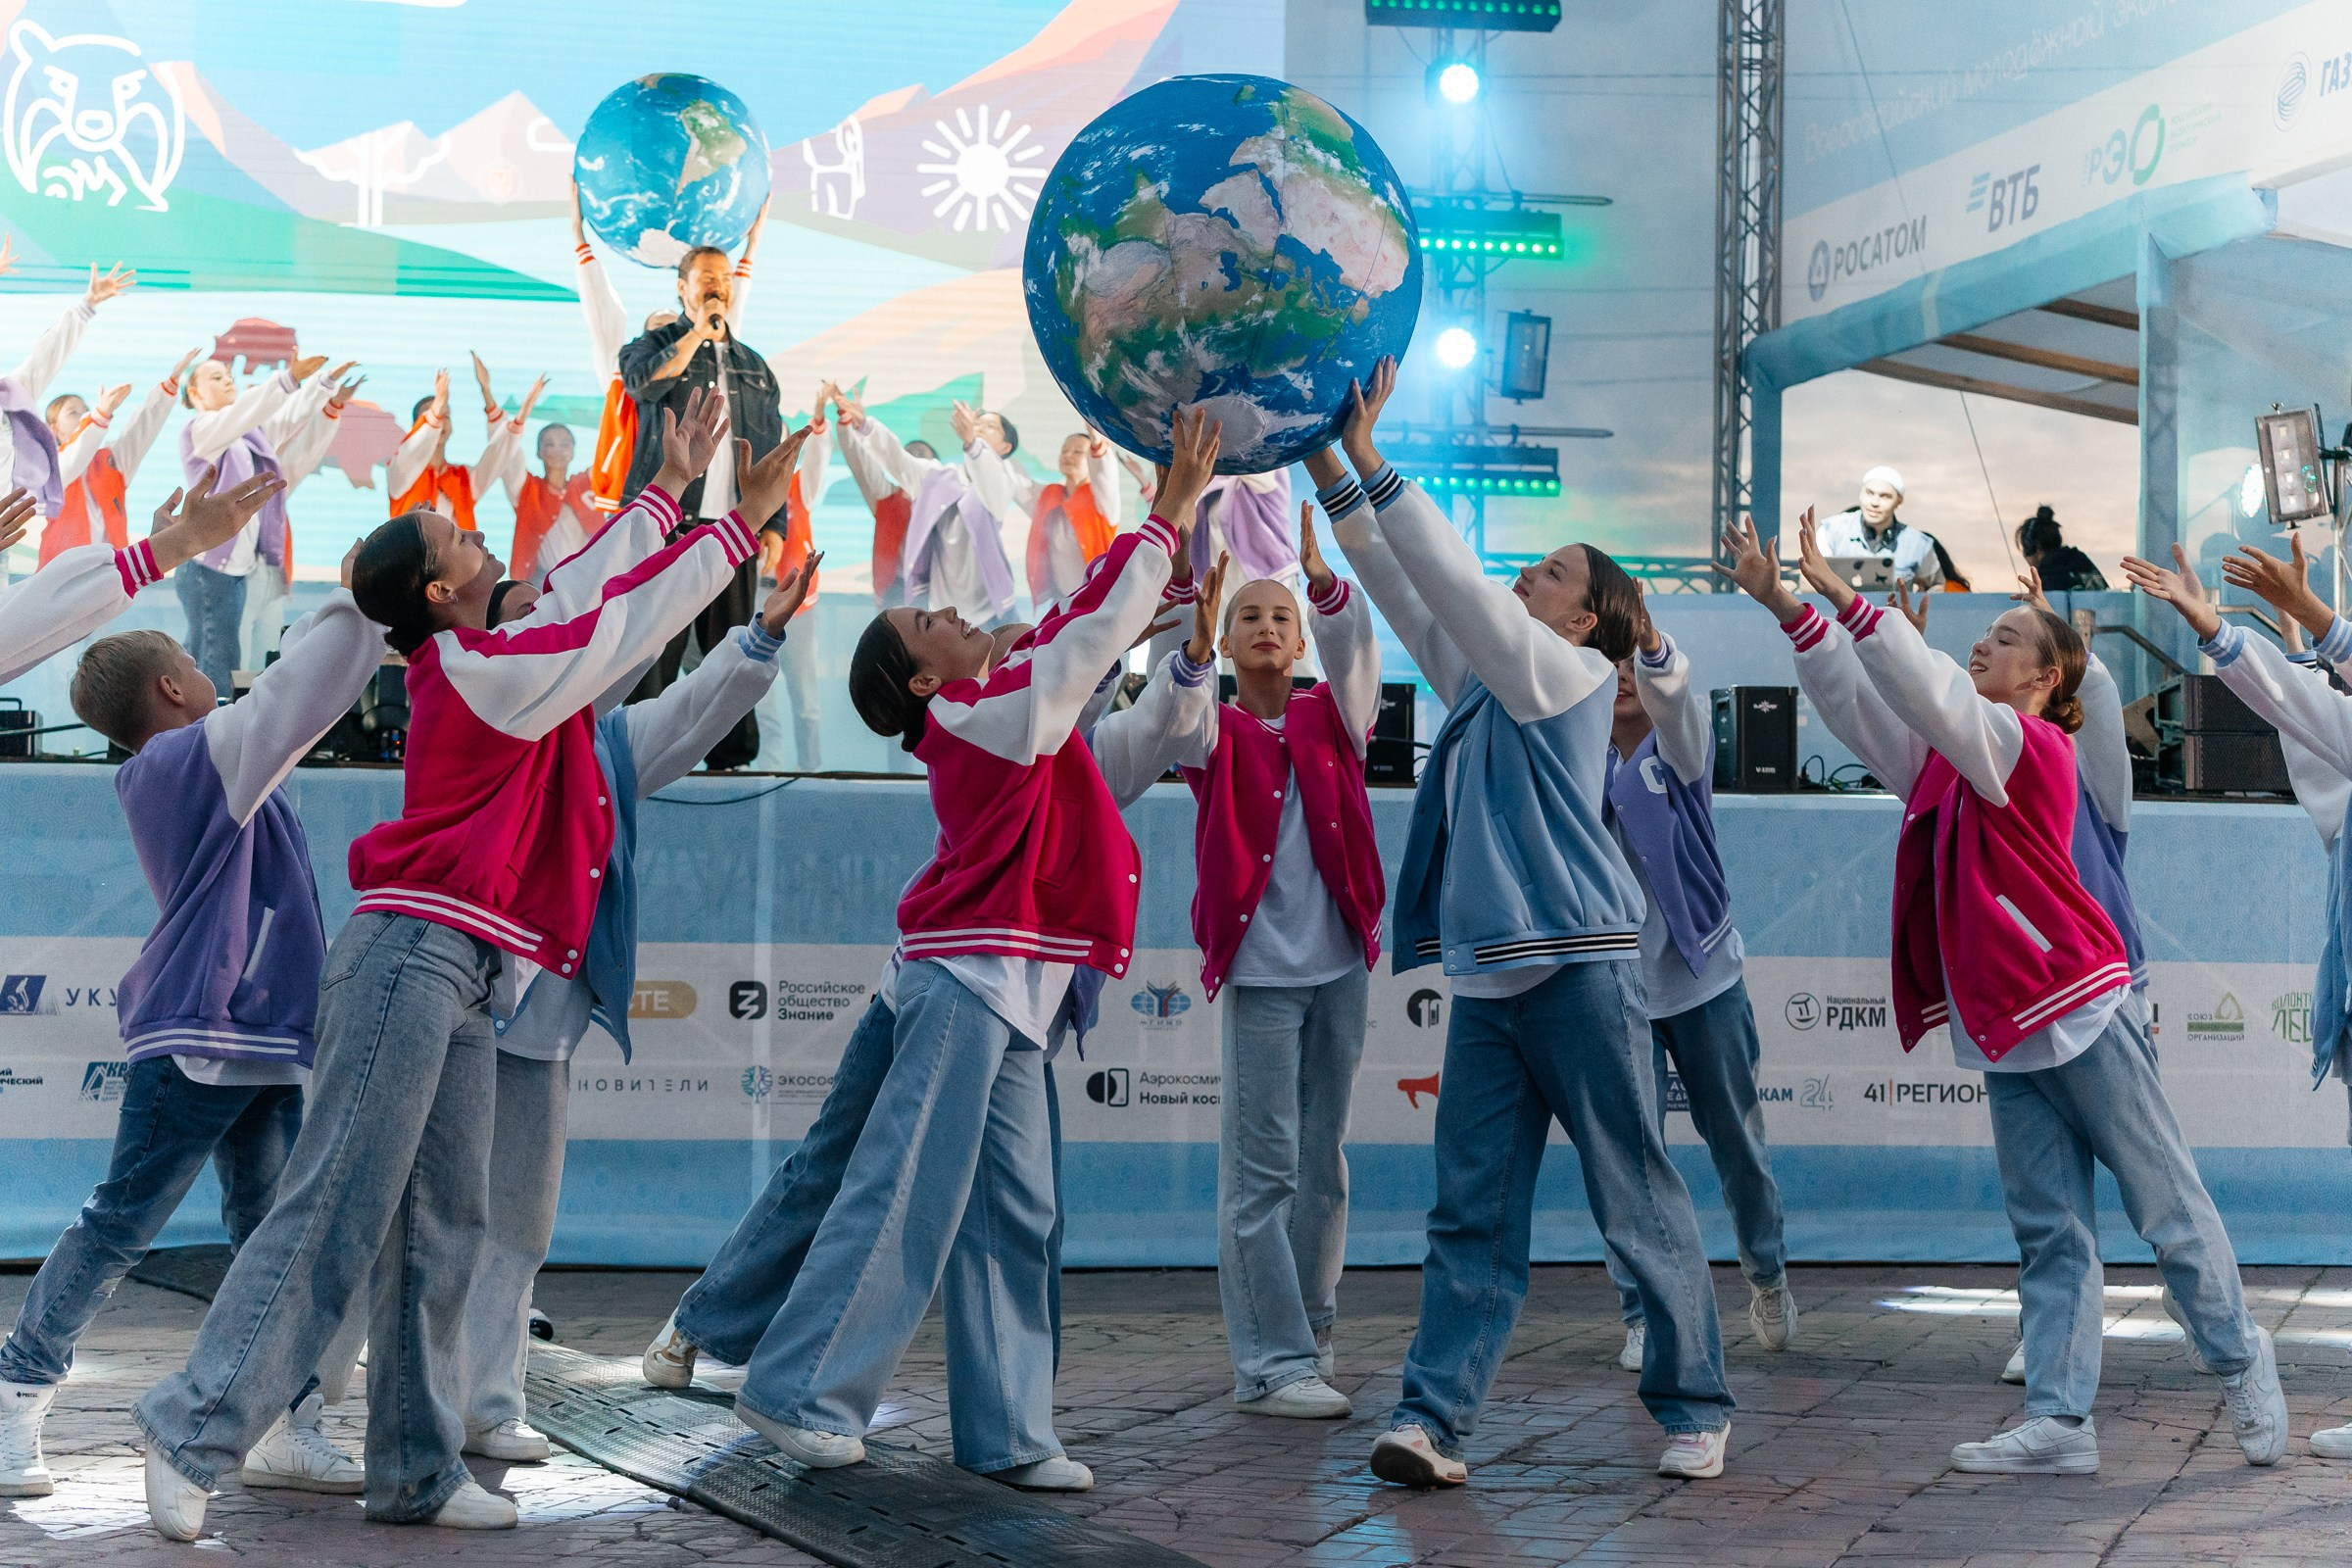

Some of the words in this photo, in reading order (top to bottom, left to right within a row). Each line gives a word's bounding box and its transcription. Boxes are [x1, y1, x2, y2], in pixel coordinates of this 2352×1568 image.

[1987, 164, 2041, 233] ВТБ
[1833, 215, 1928, 282] РОСАТОМ
[778, 980, 866, 995] Российское
[628, 990, 669, 1011] ТЕ
[778, 995, 851, 1008] общество
[1826, 996, 1886, 1005] Национальный
[2271, 992, 2313, 1010] ВОЛОНТ
[778, 1007, 835, 1021] Знание
[1826, 1005, 1886, 1031] РДКМ
[2187, 1012, 2213, 1021] СОЮЗ
[2187, 1033, 2245, 1043] ОРГАНИЗАЦИЙ
[569, 1079, 709, 1092] НОВИТЕЛИ
[1139, 1071, 1222, 1088] Аэрокосми
[1140, 1092, 1189, 1104] Новый
[1193, 1095, 1221, 1105] кос
[1864, 1083, 1885, 1103] 41
[1896, 1083, 1988, 1103] РЕГИОН
